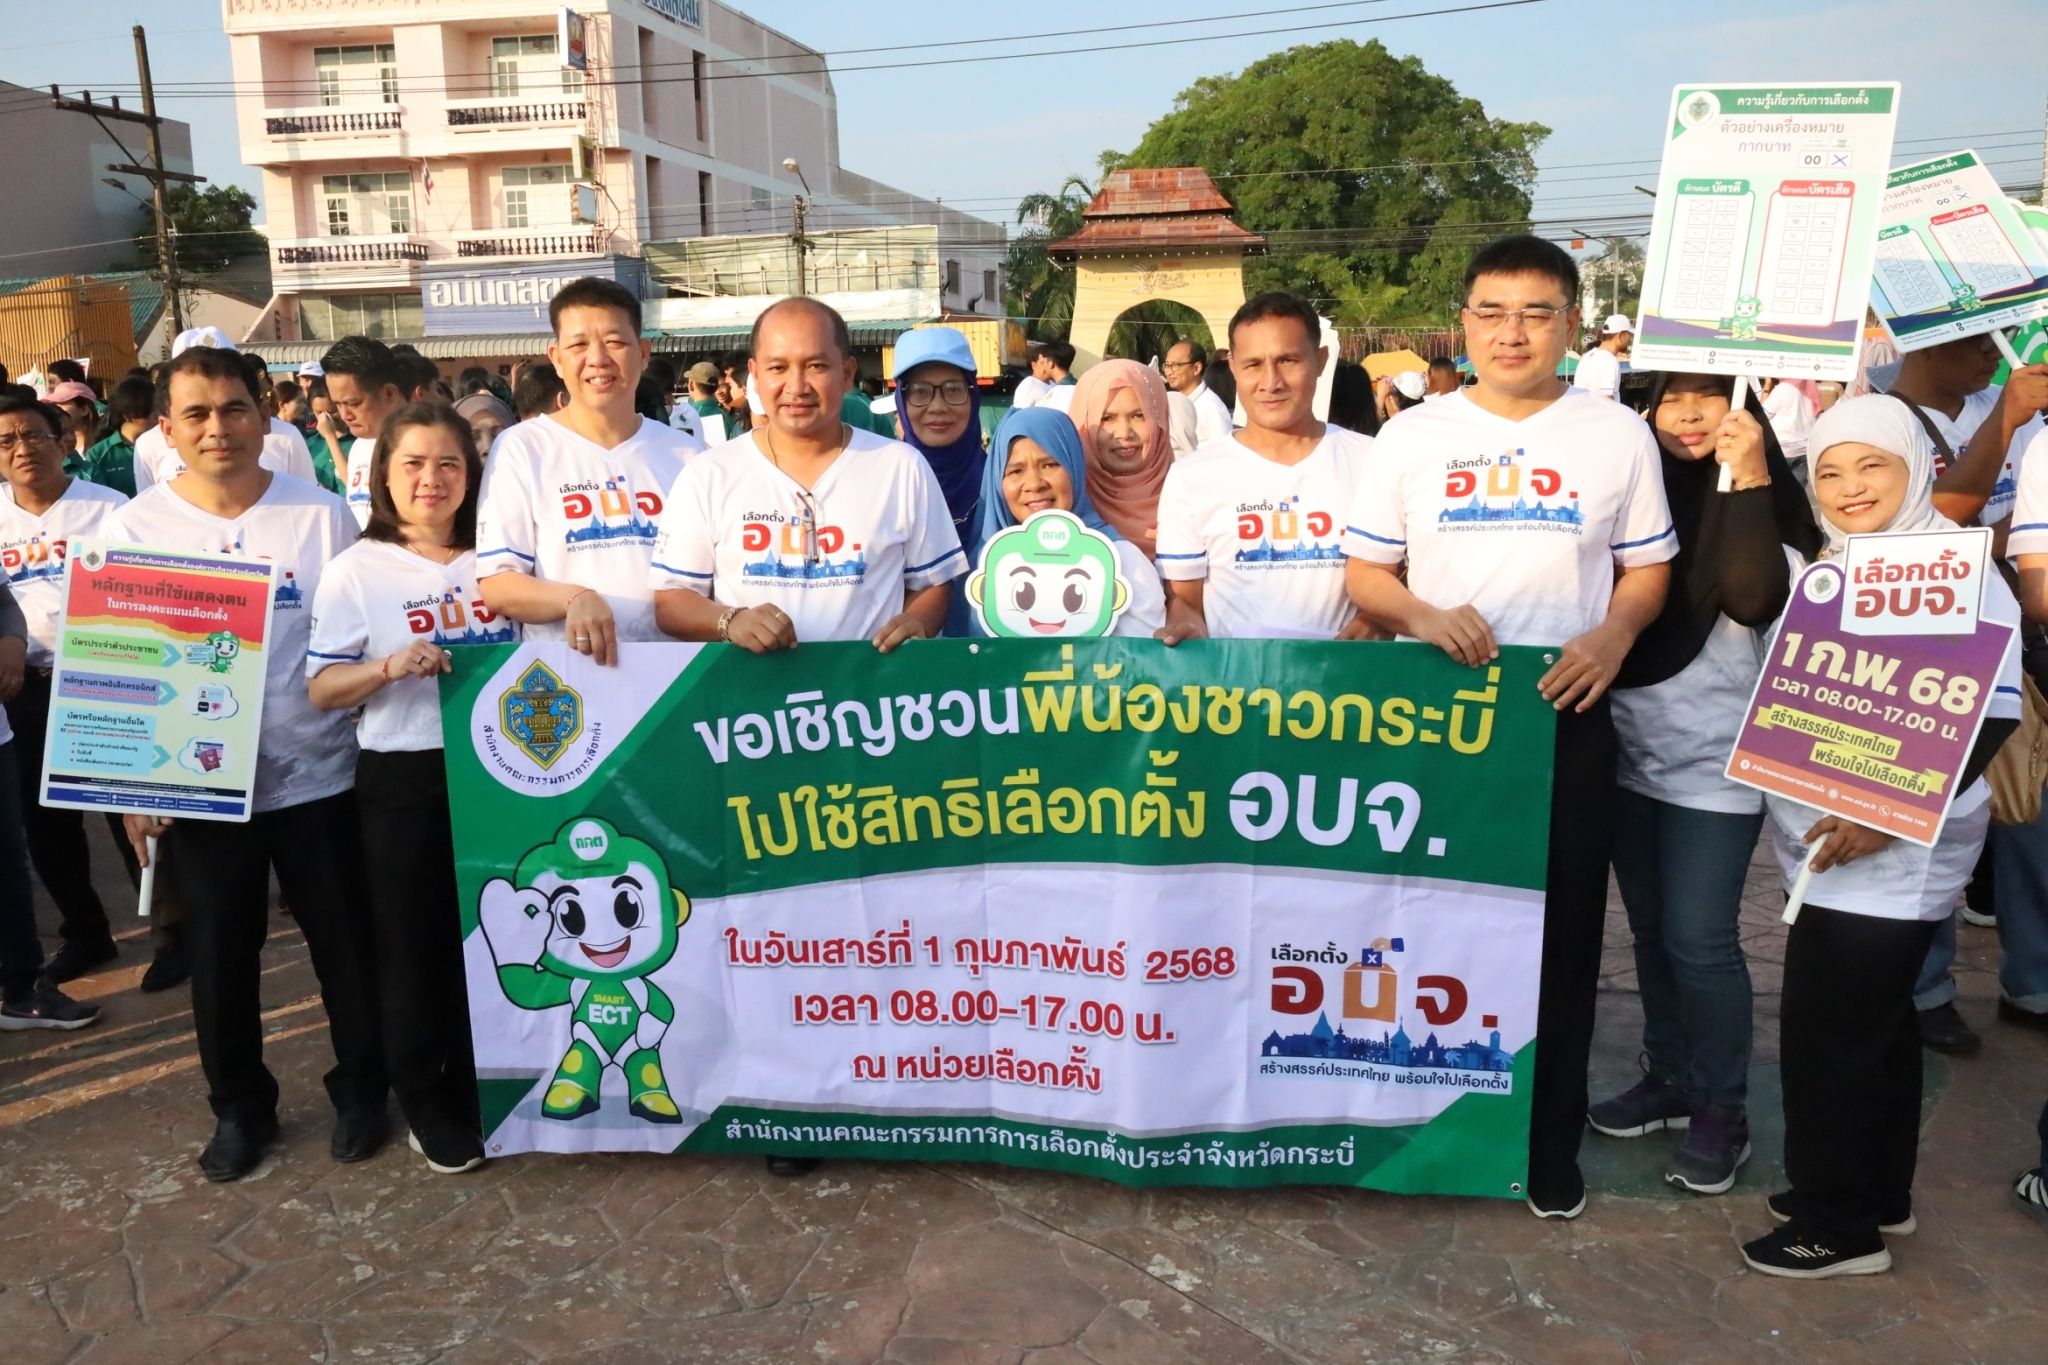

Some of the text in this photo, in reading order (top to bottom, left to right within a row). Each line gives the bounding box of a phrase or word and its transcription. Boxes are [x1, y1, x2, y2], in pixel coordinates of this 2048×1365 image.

[1737, 89, 1869, 110] ความรู้เกี่ยวกับการเลือกตั้ง
[1720, 116, 1845, 134] ตัวอย่างเครื่องหมาย
[1738, 141, 1791, 153] กากบาท
[1804, 155, 1821, 164] 00
[1712, 180, 1742, 194] บัตรดี
[430, 270, 590, 319] อนันต์สุข
[1446, 454, 1491, 470] เลือกตั้ง
[559, 479, 600, 494] เลือกตั้ง
[1445, 464, 1579, 499] อบจ.
[742, 510, 785, 523] เลือกตั้ง
[1236, 499, 1274, 513] เลือกตั้ง
[1854, 549, 1971, 585] เลือกตั้ง
[92, 577, 247, 607] หลักฐานที่ใช้แสดงตน
[402, 594, 440, 610] เลือกตั้ง
[1855, 585, 1967, 618] อบจ.
[107, 597, 229, 622] ในการลงคะแนนเลือกตั้ง
[71, 638, 159, 654] บัตรประจำตัวประชาชน
[1781, 632, 1980, 715] 1 ก.พ. 68
[1772, 675, 1959, 742] เวลา 08.00-17.00 น.
[1770, 707, 1896, 756] สร้างสรรค์ประเทศไทย
[1814, 748, 1926, 794] พร้อมใจไปเลือกตั้ง
[727, 750, 1447, 860] ไปใช้สิทธิเลือกตั้ง อบจ.
[724, 919, 1237, 982] ในวันเสาร์ที่ 1 กุมภาพันธ์ 2568
[1271, 942, 1348, 965] เลือกตั้ง
[593, 994, 626, 1004] SMART
[1271, 962, 1498, 1028] อบจ.
[588, 1004, 631, 1025] ECT
[793, 989, 1176, 1042] เวลา 08.00-17.00 น.
[853, 1045, 1102, 1093] ณ หน่วยเลือกตั้ง
[1260, 1062, 1509, 1091] สร้างสรรค์ประเทศไทย พร้อมใจไปเลือกตั้ง
[725, 1118, 1355, 1169] สำนักงานคณะกรรมการการเลือกตั้งประจำจังหวัดกระบี่
